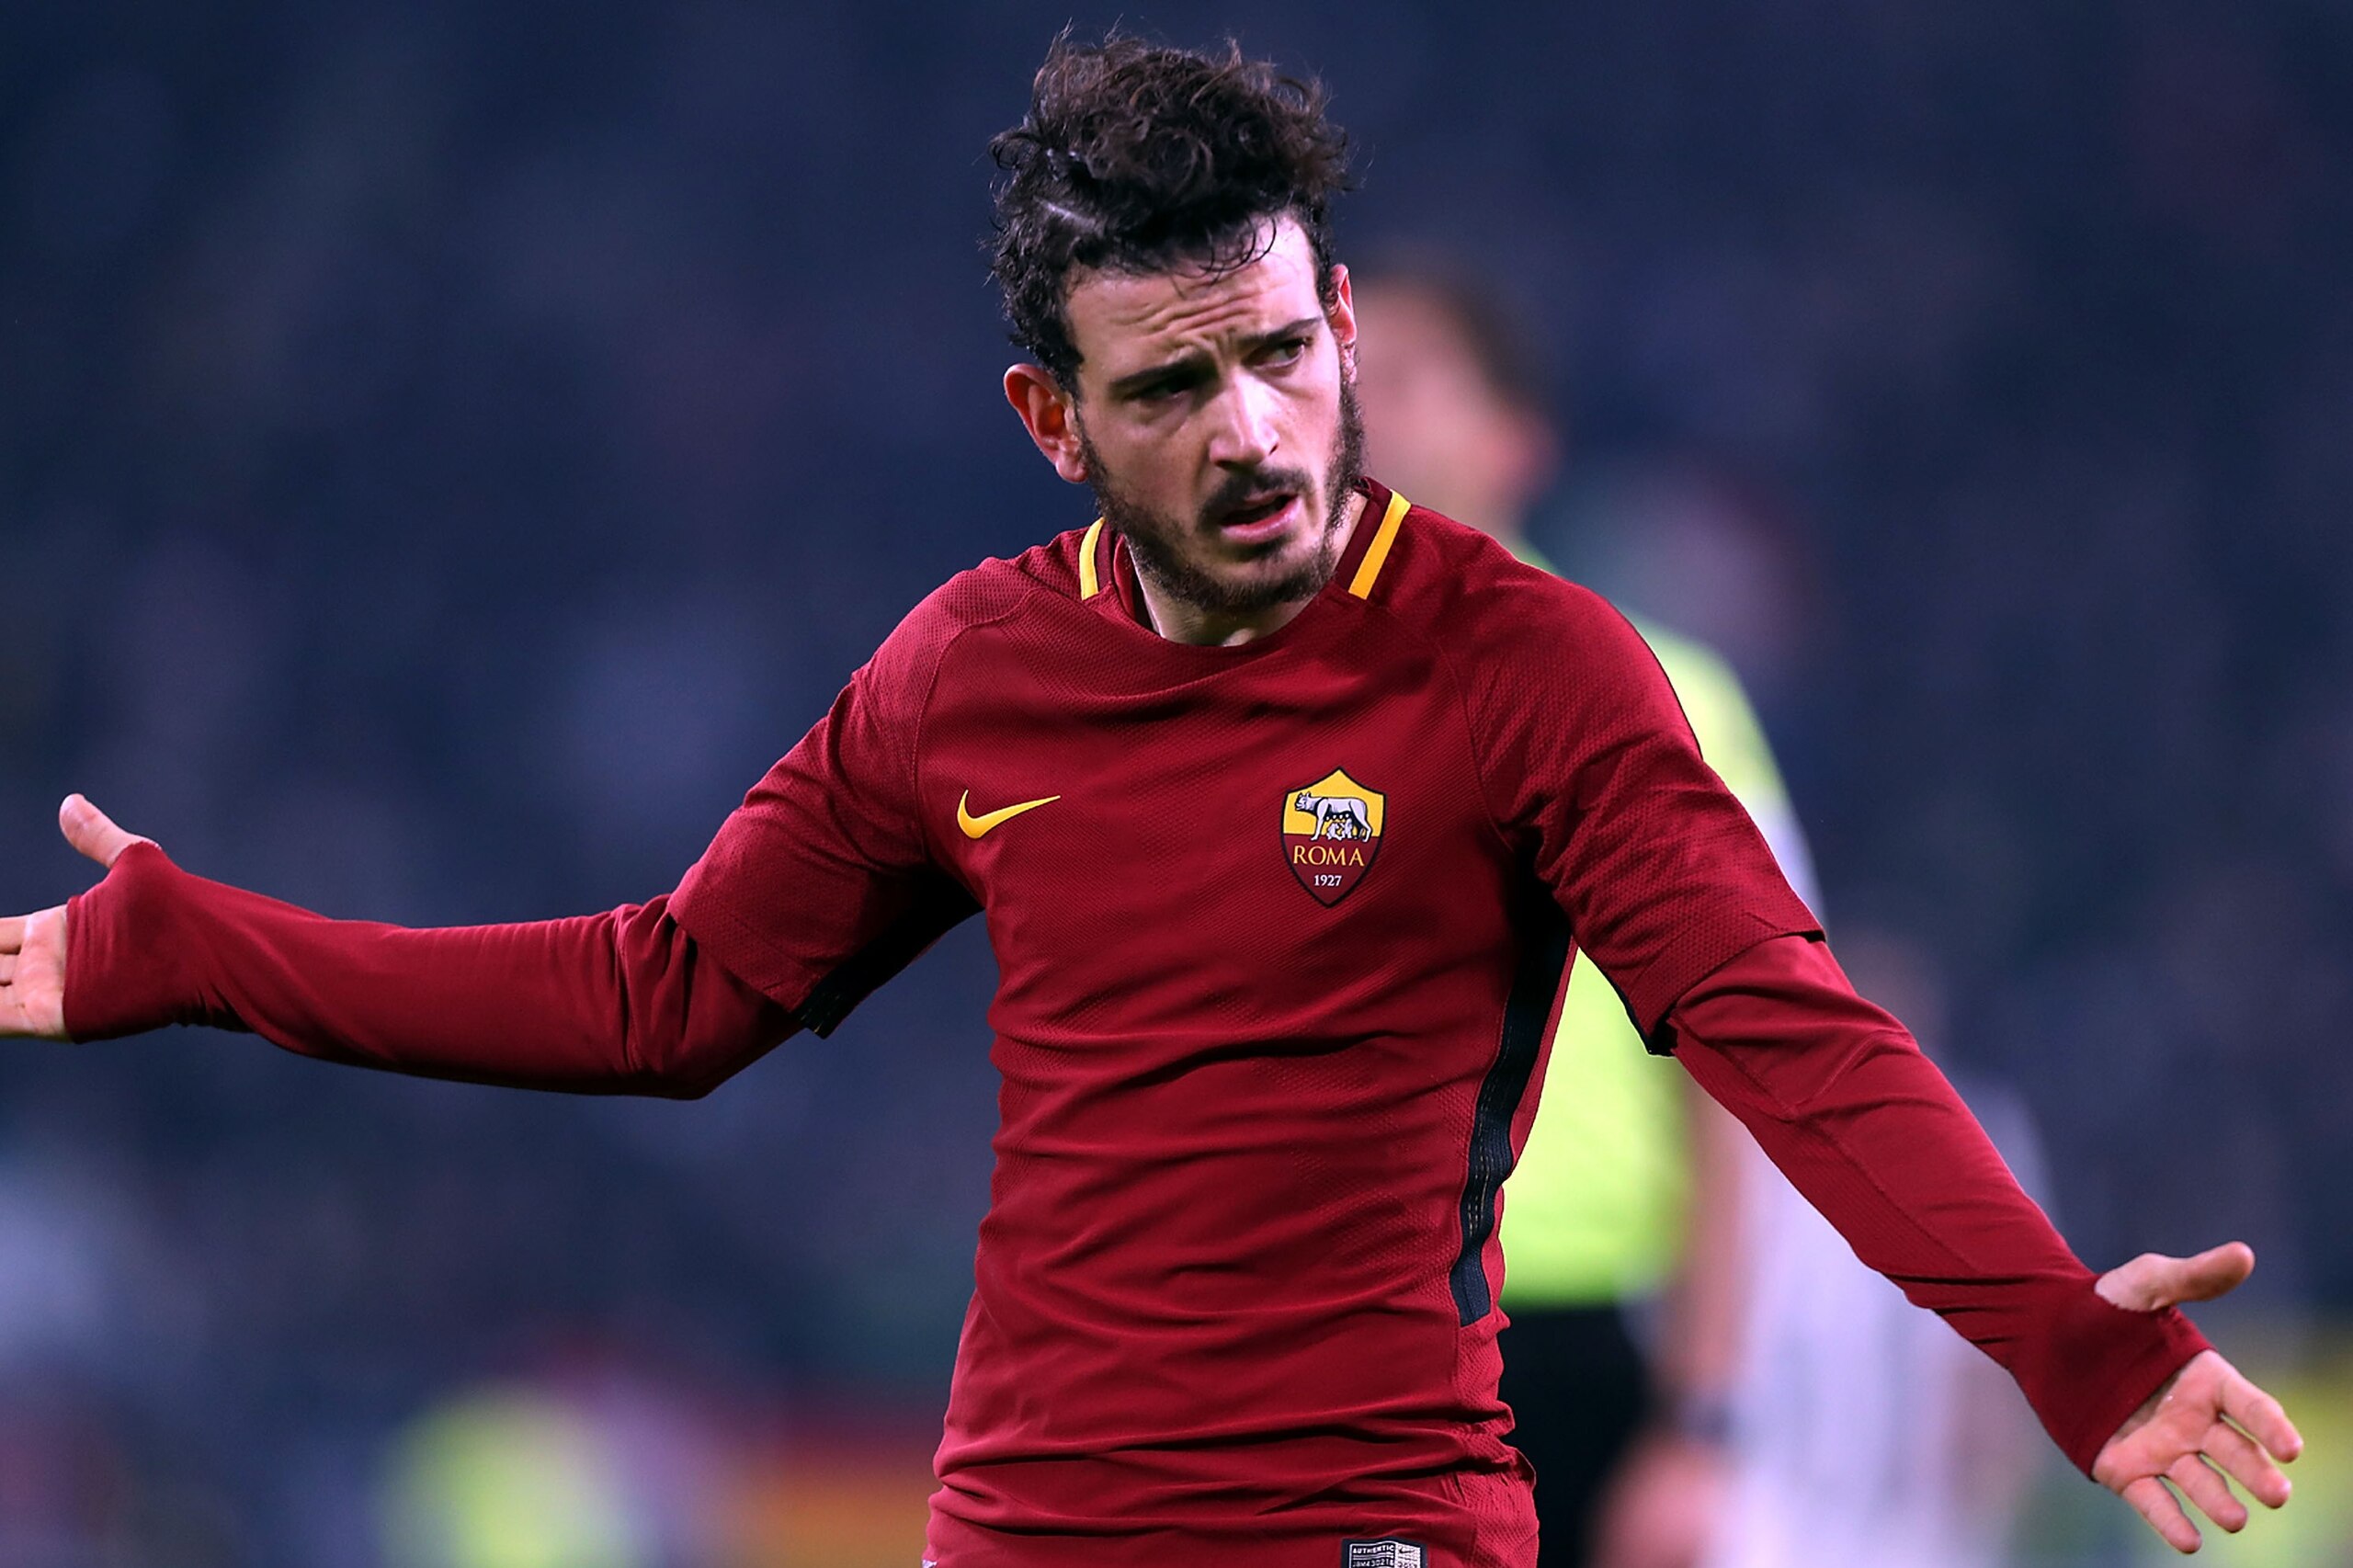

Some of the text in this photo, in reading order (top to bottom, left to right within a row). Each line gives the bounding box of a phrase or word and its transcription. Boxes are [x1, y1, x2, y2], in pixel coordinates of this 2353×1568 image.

[1293, 845, 1365, 867] ROMA
[1314, 874, 1342, 887] 1927
[1352, 1544, 1395, 1554] AUTHENTIC
